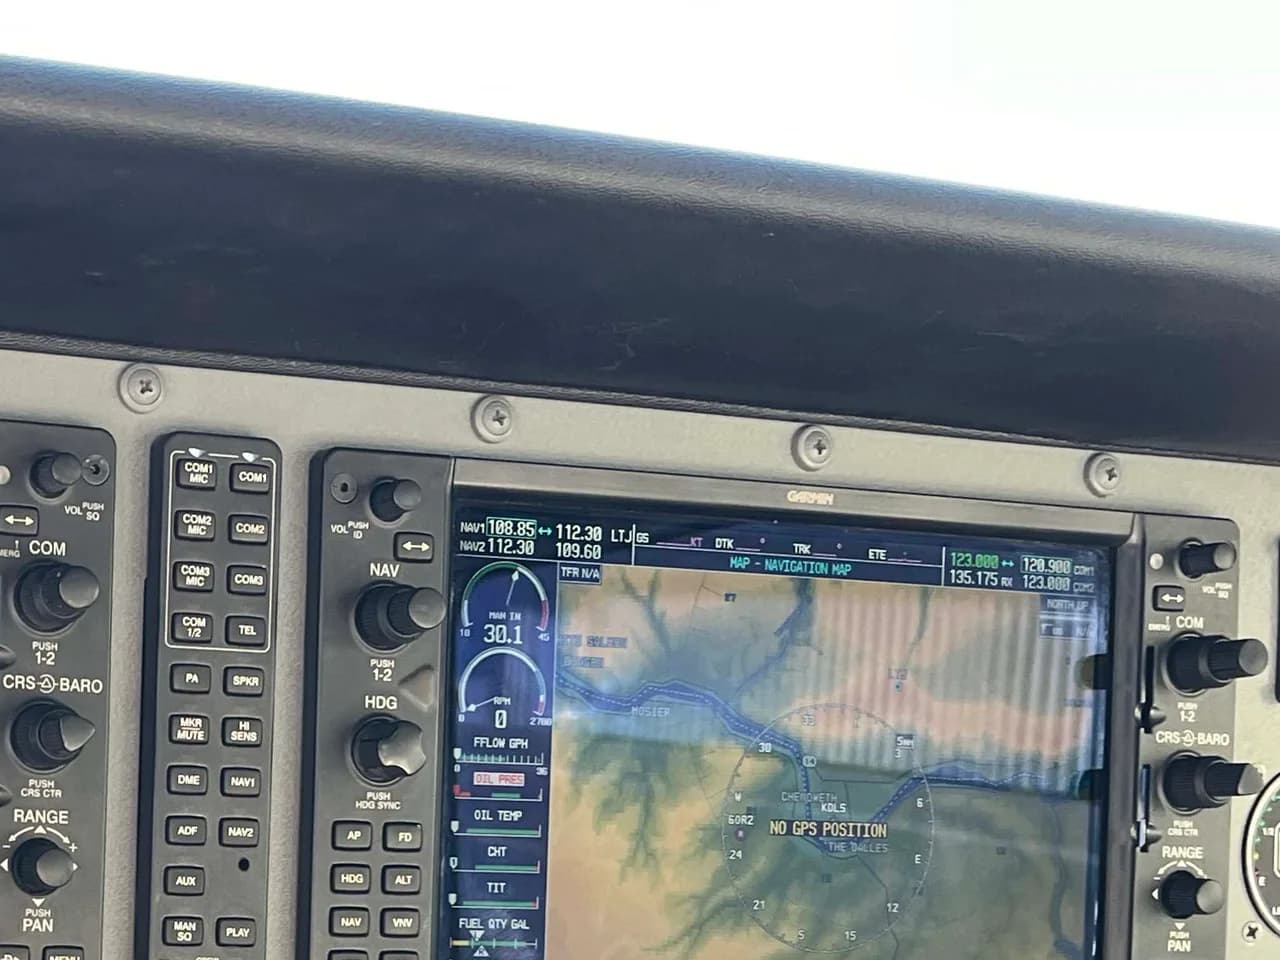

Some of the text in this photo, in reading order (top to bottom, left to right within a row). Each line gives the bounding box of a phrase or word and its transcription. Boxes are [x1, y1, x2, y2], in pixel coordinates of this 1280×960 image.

[239, 472, 267, 483] COM1
[64, 502, 104, 516] VOL PUSH
[236, 523, 264, 534] COM2
[488, 519, 602, 541] 108.85 112.30
[29, 540, 66, 556] COM
[370, 563, 399, 578] NAV
[764, 559, 852, 576] NAVIGATION MAP
[950, 570, 998, 586] 135.175
[1176, 616, 1203, 629] COM
[239, 624, 256, 635] TEL
[484, 624, 523, 645] 30.1
[32, 641, 58, 652] PUSH
[3, 674, 103, 694] CRS BARO
[233, 676, 259, 686] SPKR
[365, 695, 397, 710] HDG
[474, 737, 528, 749] FFLOW GPH
[178, 775, 200, 785] DME
[14, 809, 69, 825] RANGE
[474, 810, 522, 821] OIL TEMP
[178, 826, 197, 836] ADF
[228, 827, 253, 837] NAV2
[770, 821, 887, 838] NO GPS POSITION
[1162, 846, 1203, 859] RANGE
[22, 918, 53, 932] PAN
[226, 927, 250, 938] PLAY
